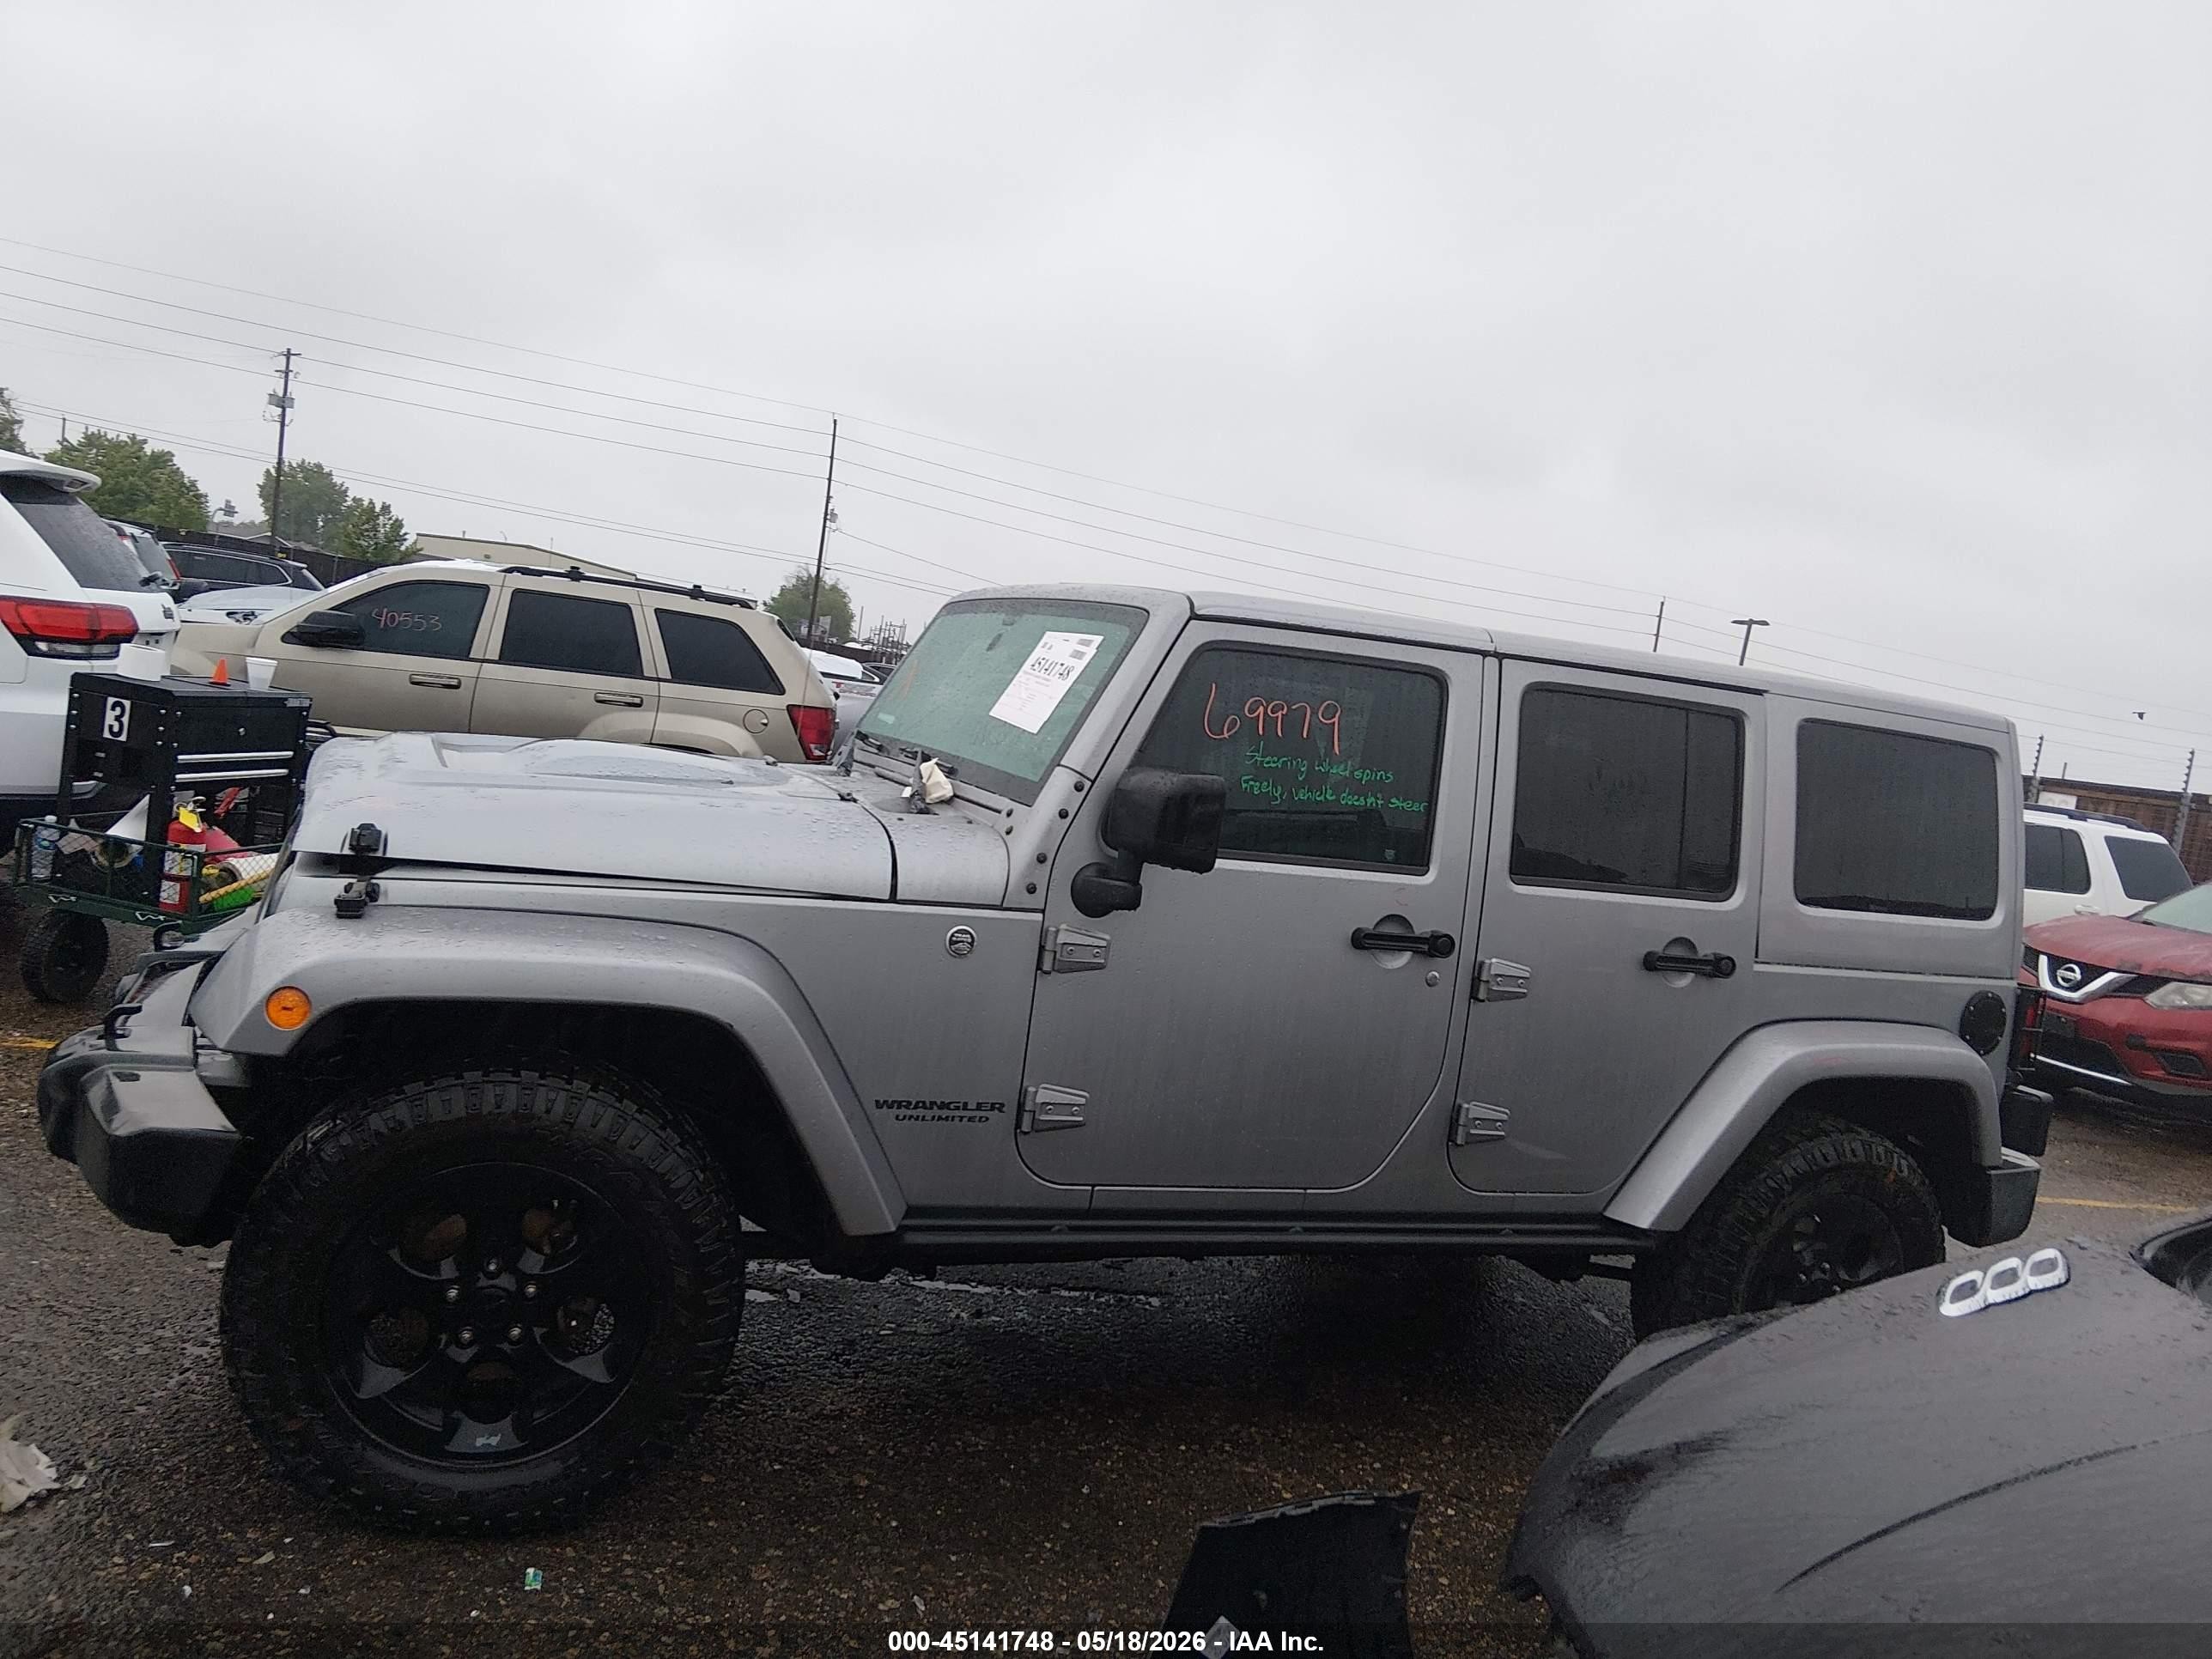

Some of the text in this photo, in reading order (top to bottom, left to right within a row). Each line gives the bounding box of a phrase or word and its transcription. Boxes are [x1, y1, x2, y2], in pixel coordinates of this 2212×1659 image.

[371, 607, 443, 631] 40553
[1030, 657, 1075, 681] 45141748
[108, 700, 127, 738] 3
[1204, 683, 1341, 756] 69979
[874, 1099, 1006, 1114] WRANGLER
[895, 1114, 990, 1123] UNLIMITED
